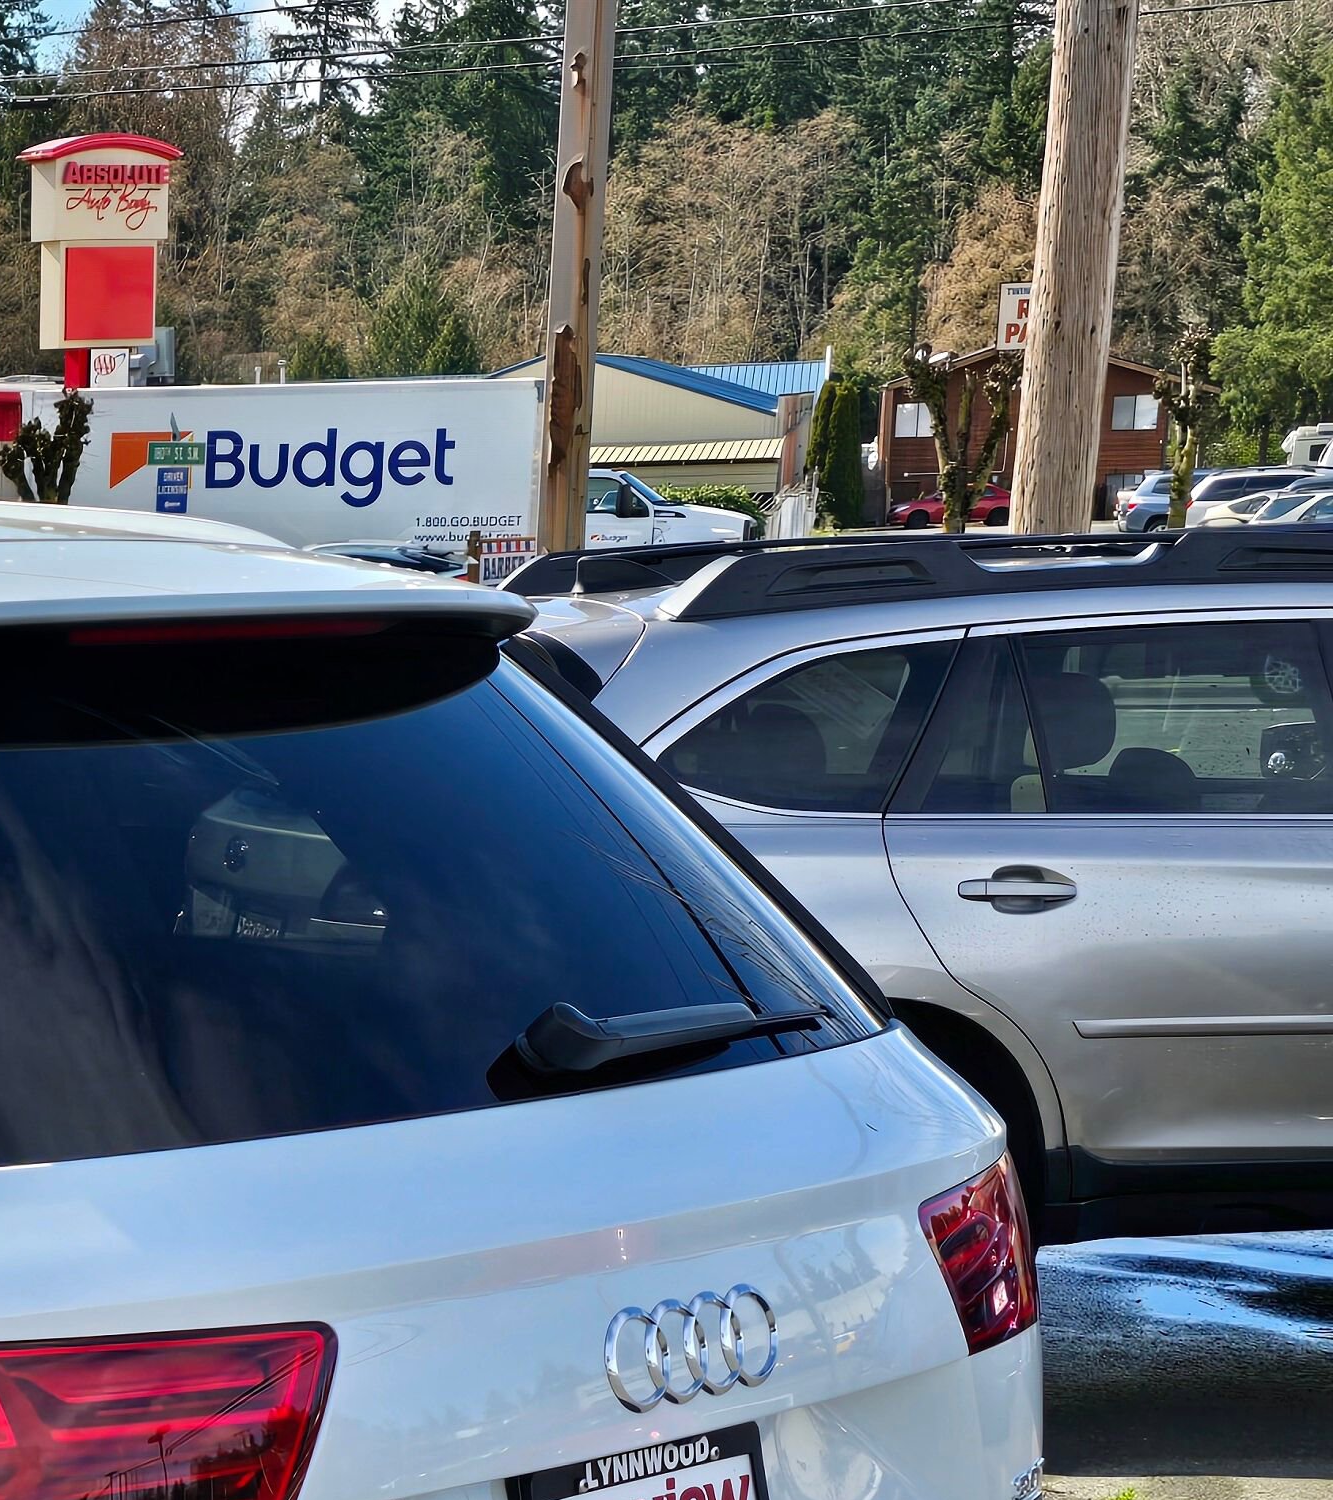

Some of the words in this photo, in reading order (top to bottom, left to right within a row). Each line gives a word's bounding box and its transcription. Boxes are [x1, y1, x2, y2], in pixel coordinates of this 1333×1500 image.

[62, 162, 169, 184] ABSOLUTE
[66, 184, 118, 220] Auto
[115, 184, 157, 230] Body
[205, 428, 455, 508] Budget
[415, 515, 522, 528] 1.800.GO.BUDGET
[585, 1436, 711, 1489] LYNNWOOD
